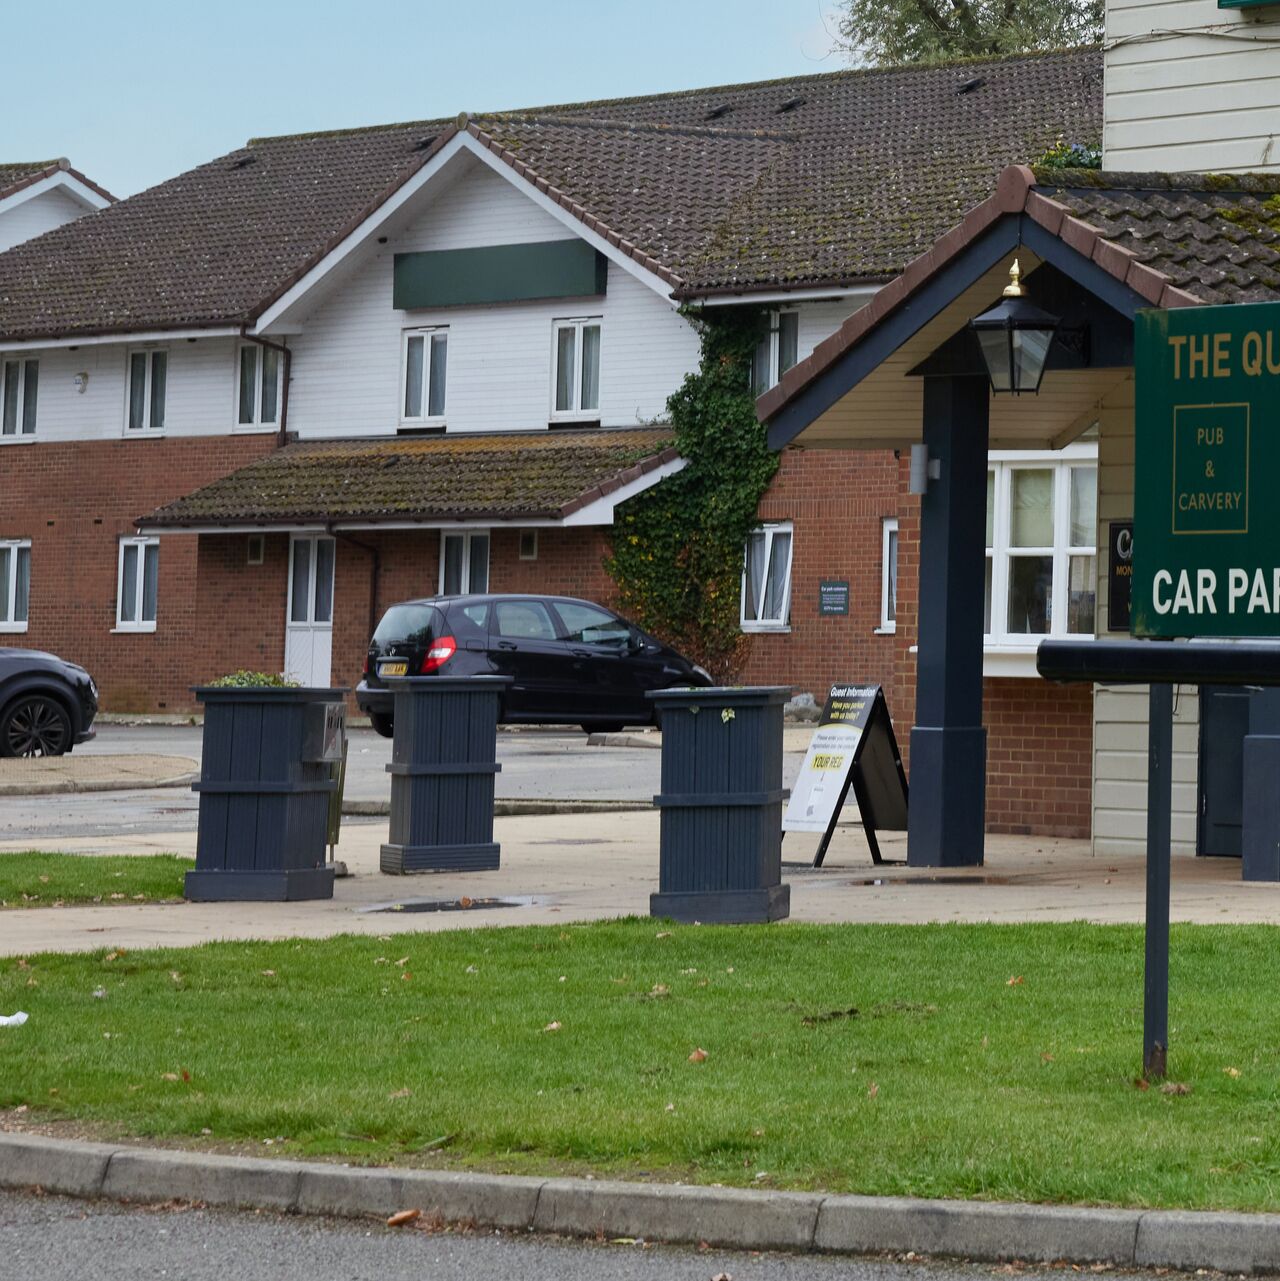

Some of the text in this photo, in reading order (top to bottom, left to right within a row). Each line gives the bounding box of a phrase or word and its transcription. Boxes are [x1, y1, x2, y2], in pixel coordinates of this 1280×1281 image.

[1168, 332, 1232, 380] THE
[1197, 427, 1224, 445] PUB
[1205, 460, 1215, 477] &
[1178, 492, 1242, 511] CARVERY
[1152, 568, 1217, 614] CAR
[830, 686, 876, 697] Guest Information
